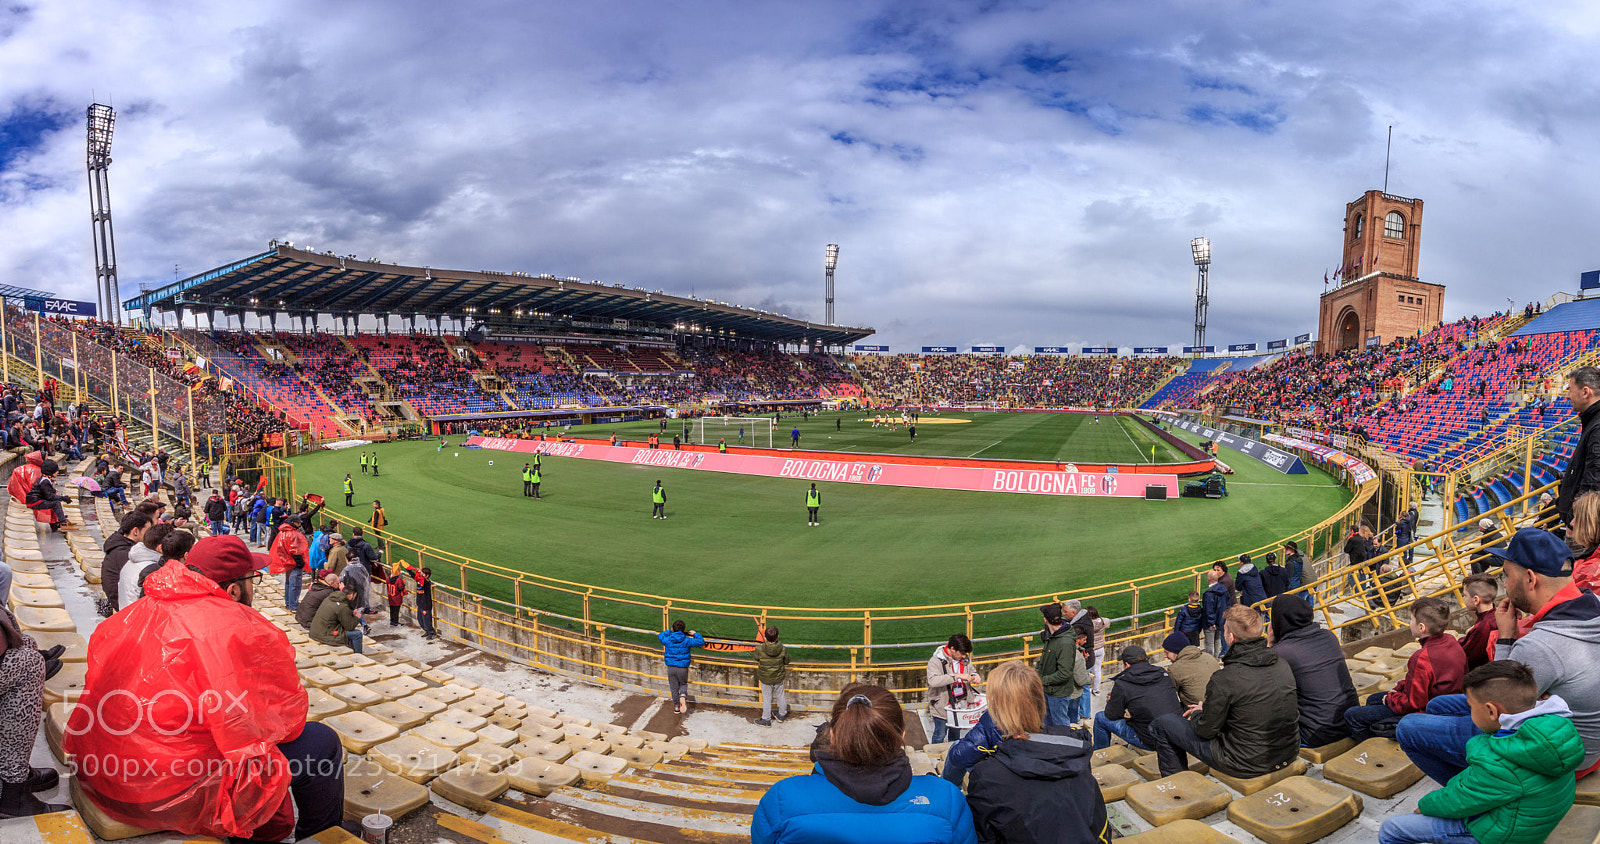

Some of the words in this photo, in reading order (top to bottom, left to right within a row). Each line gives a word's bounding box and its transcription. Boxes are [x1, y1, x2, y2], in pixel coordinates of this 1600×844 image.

[45, 300, 78, 312] FAAC
[632, 449, 682, 467] BOLOGNA
[680, 452, 693, 463] FC
[779, 459, 849, 480] BOLOGNA
[850, 463, 866, 476] FC
[992, 470, 1077, 494] BOLOGNA
[1081, 474, 1096, 488] FC
[1080, 487, 1096, 495] 1909
